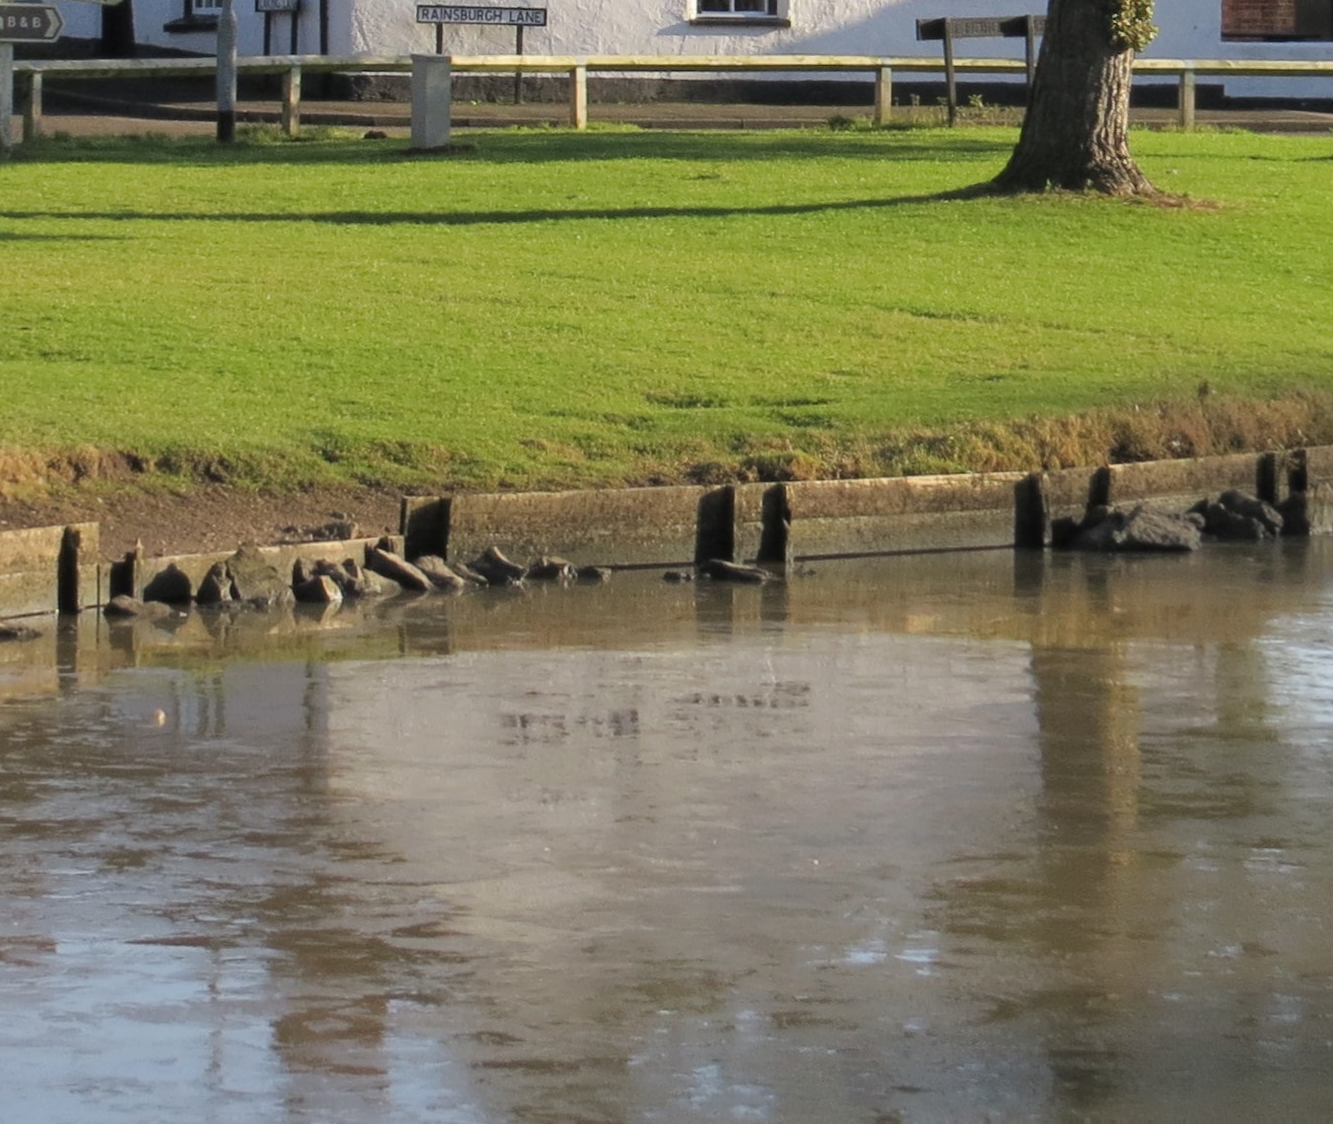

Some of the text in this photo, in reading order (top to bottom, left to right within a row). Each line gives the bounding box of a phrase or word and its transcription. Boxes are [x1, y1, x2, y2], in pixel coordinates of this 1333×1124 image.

[7, 15, 42, 28] B & B
[421, 7, 542, 24] RAINSBURGH LANE
